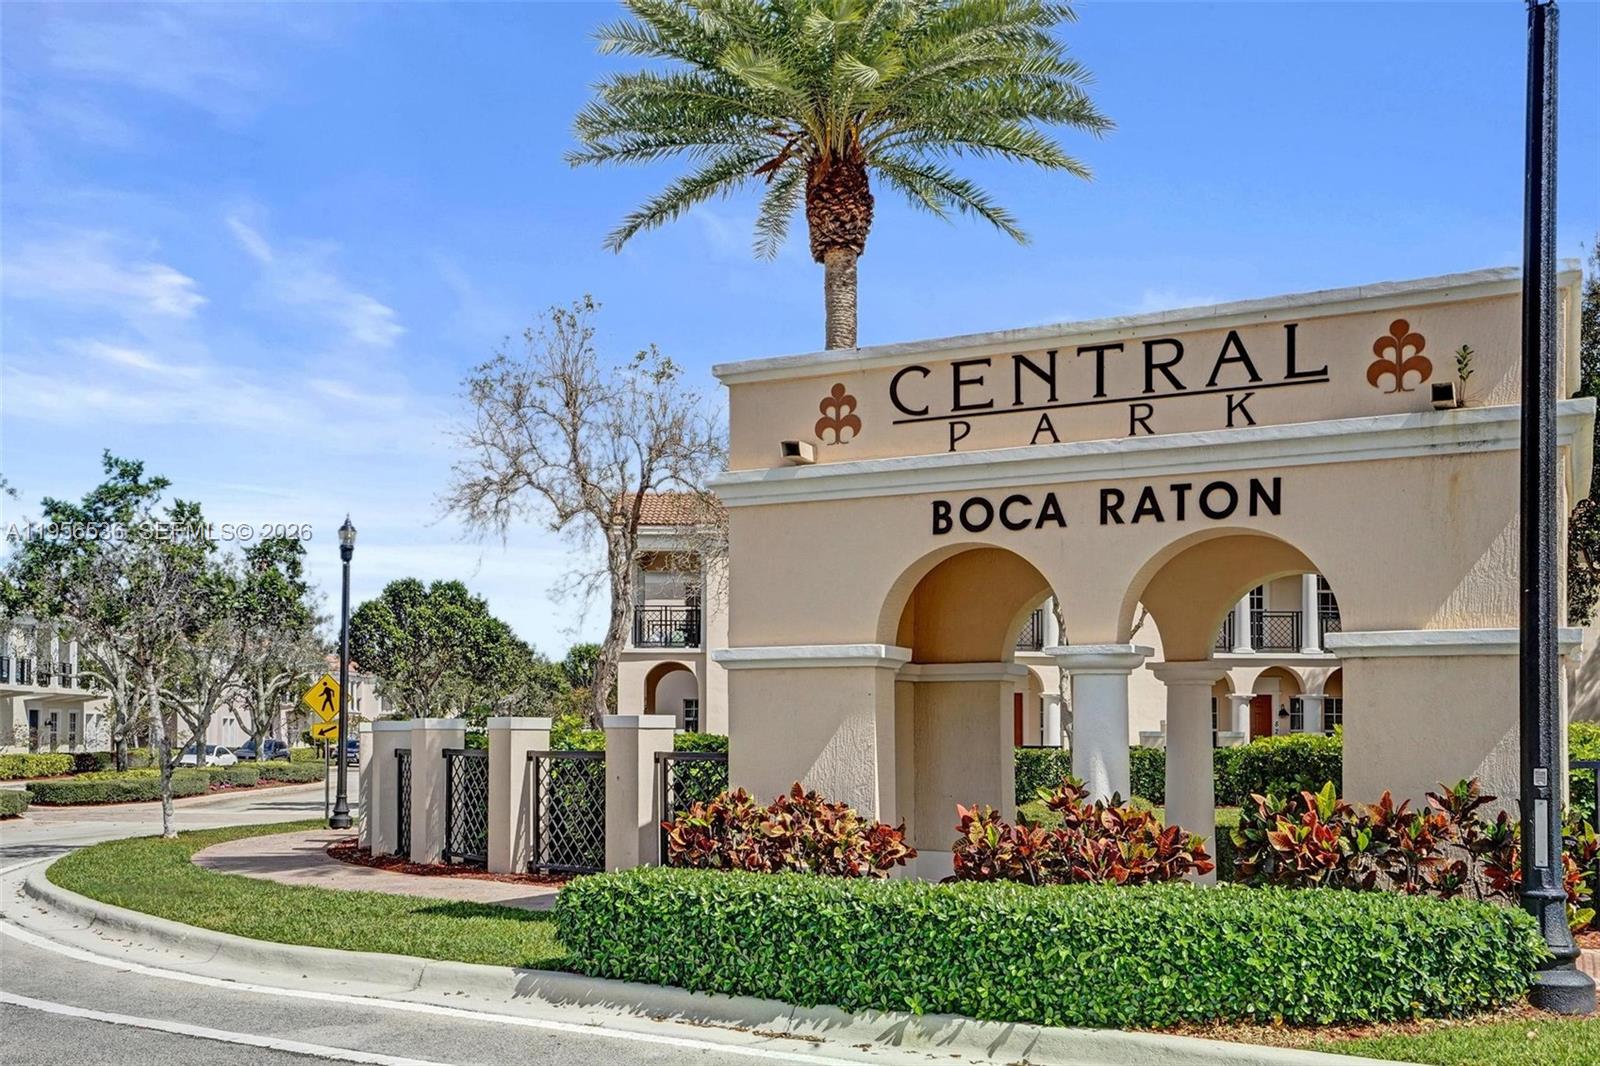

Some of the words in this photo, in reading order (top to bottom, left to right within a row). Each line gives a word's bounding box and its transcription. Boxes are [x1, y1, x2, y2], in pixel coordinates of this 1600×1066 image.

[889, 323, 1329, 416] CENTRAL
[948, 392, 1257, 453] PARK
[931, 492, 1068, 536] BOCA
[1099, 477, 1283, 526] RATON
